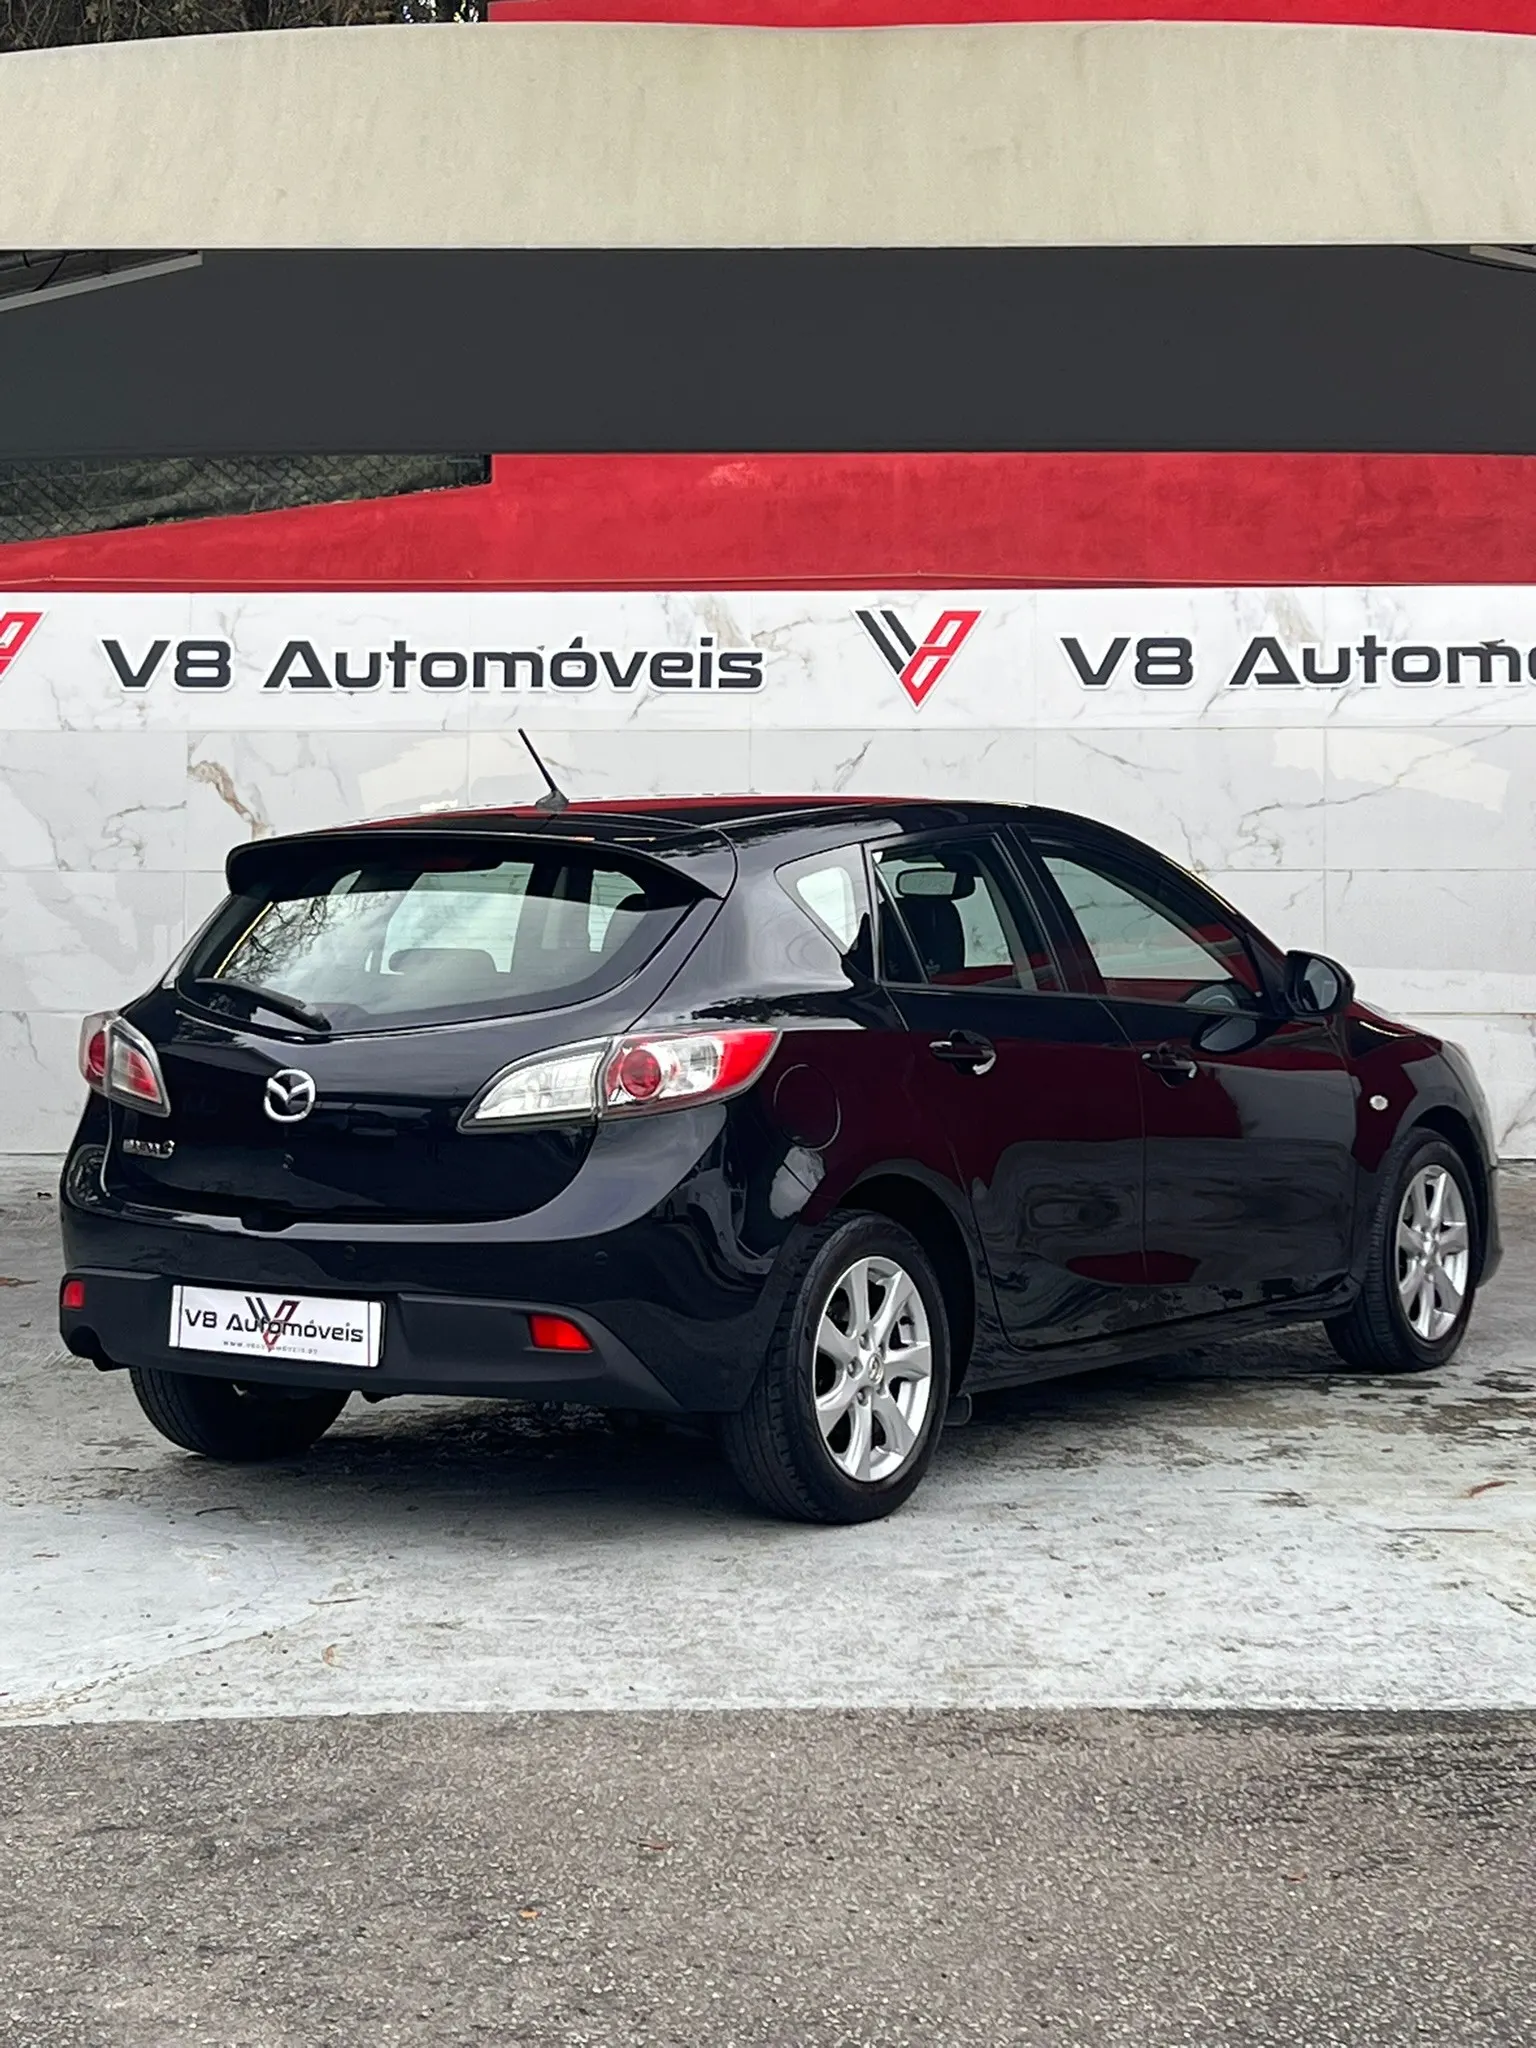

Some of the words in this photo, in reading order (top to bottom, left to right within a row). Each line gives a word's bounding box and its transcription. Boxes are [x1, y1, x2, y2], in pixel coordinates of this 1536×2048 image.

[102, 639, 231, 688] V8
[263, 636, 763, 689] Automóveis
[1060, 637, 1194, 686] V8
[1229, 634, 1536, 686] Autom
[184, 1308, 218, 1329] V8
[225, 1313, 364, 1343] Automóveis
